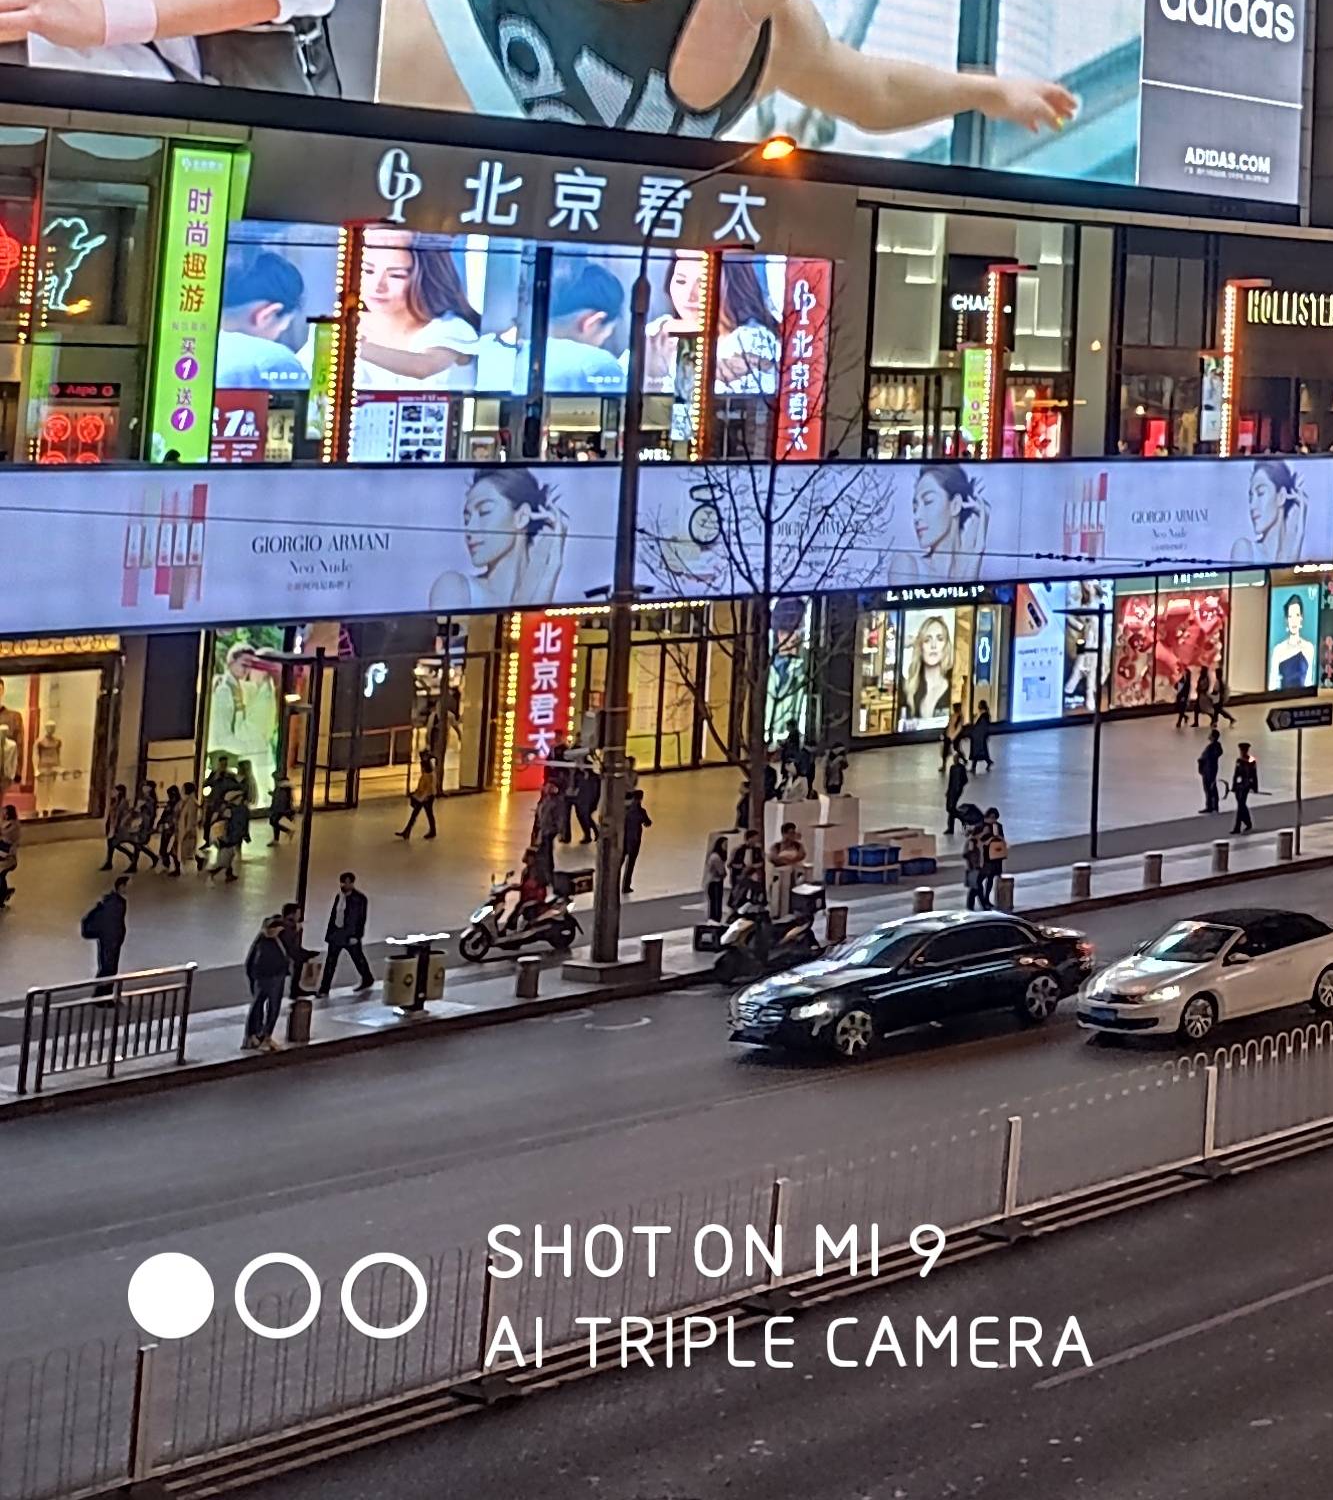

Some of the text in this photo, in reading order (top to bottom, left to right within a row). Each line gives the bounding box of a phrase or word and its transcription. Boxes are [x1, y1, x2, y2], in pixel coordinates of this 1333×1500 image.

[460, 160, 767, 244] 北京君太
[1184, 146, 1271, 174] ADIDAS.COM
[179, 188, 214, 313] 时尚趣游
[785, 329, 814, 452] 北京君太
[251, 532, 391, 554] GIORGIO ARMANI
[1131, 508, 1209, 525] GIORGIO ARMANI
[527, 621, 563, 760] 北京君太
